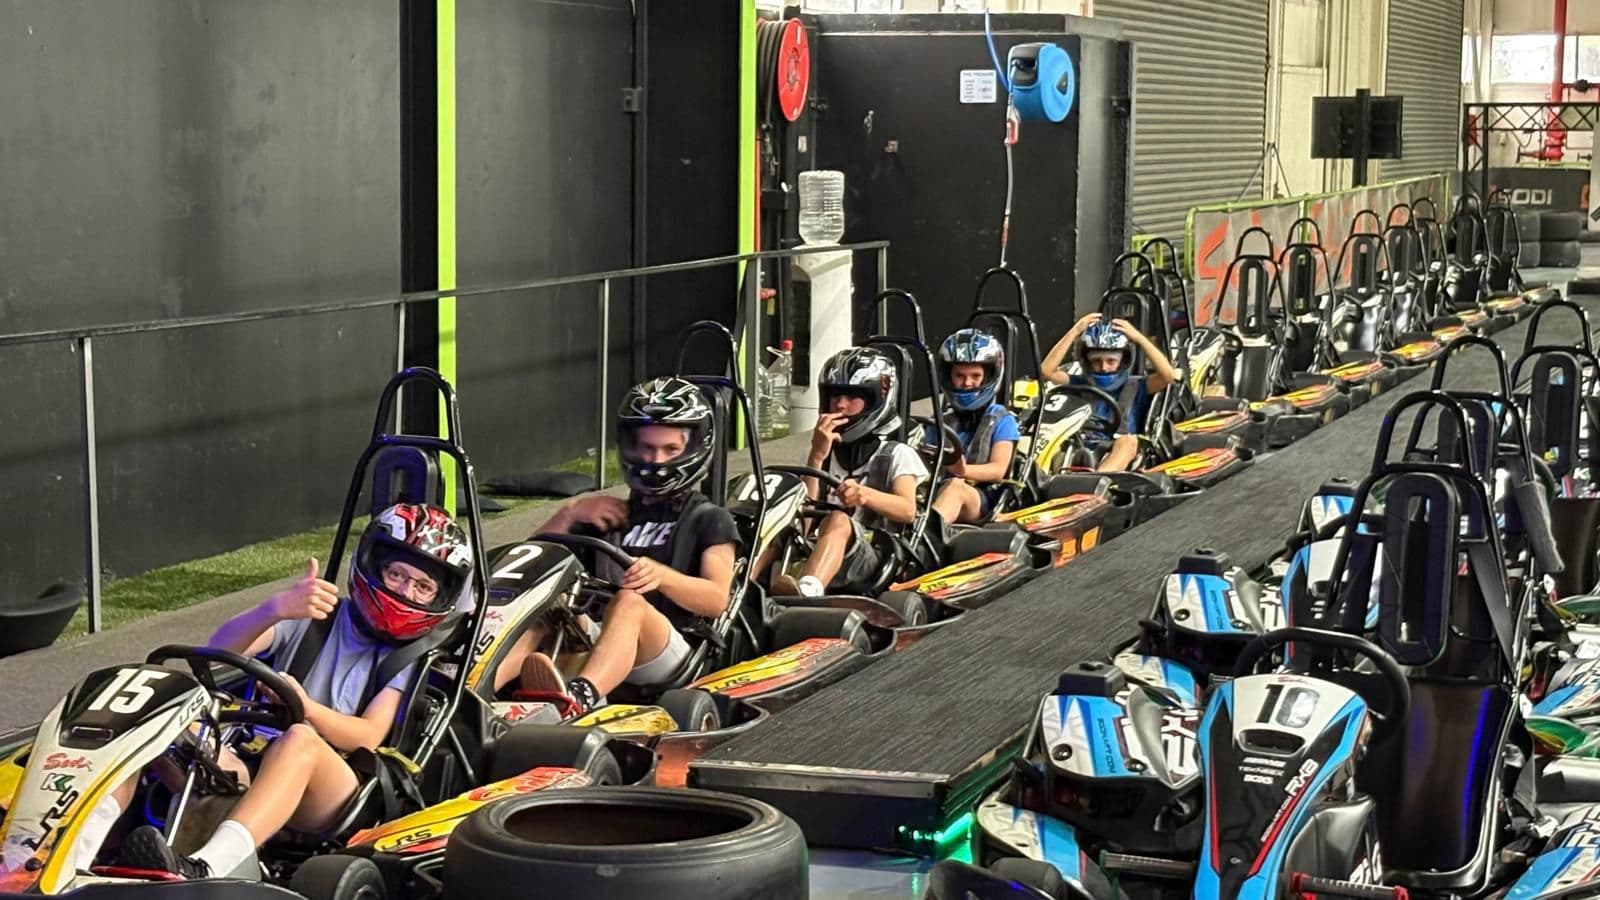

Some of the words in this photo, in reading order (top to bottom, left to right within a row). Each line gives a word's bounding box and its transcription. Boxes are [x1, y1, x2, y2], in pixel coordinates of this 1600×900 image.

[1044, 394, 1068, 411] 3
[492, 544, 544, 580] 2
[88, 668, 171, 714] 15
[1256, 683, 1321, 728] 10
